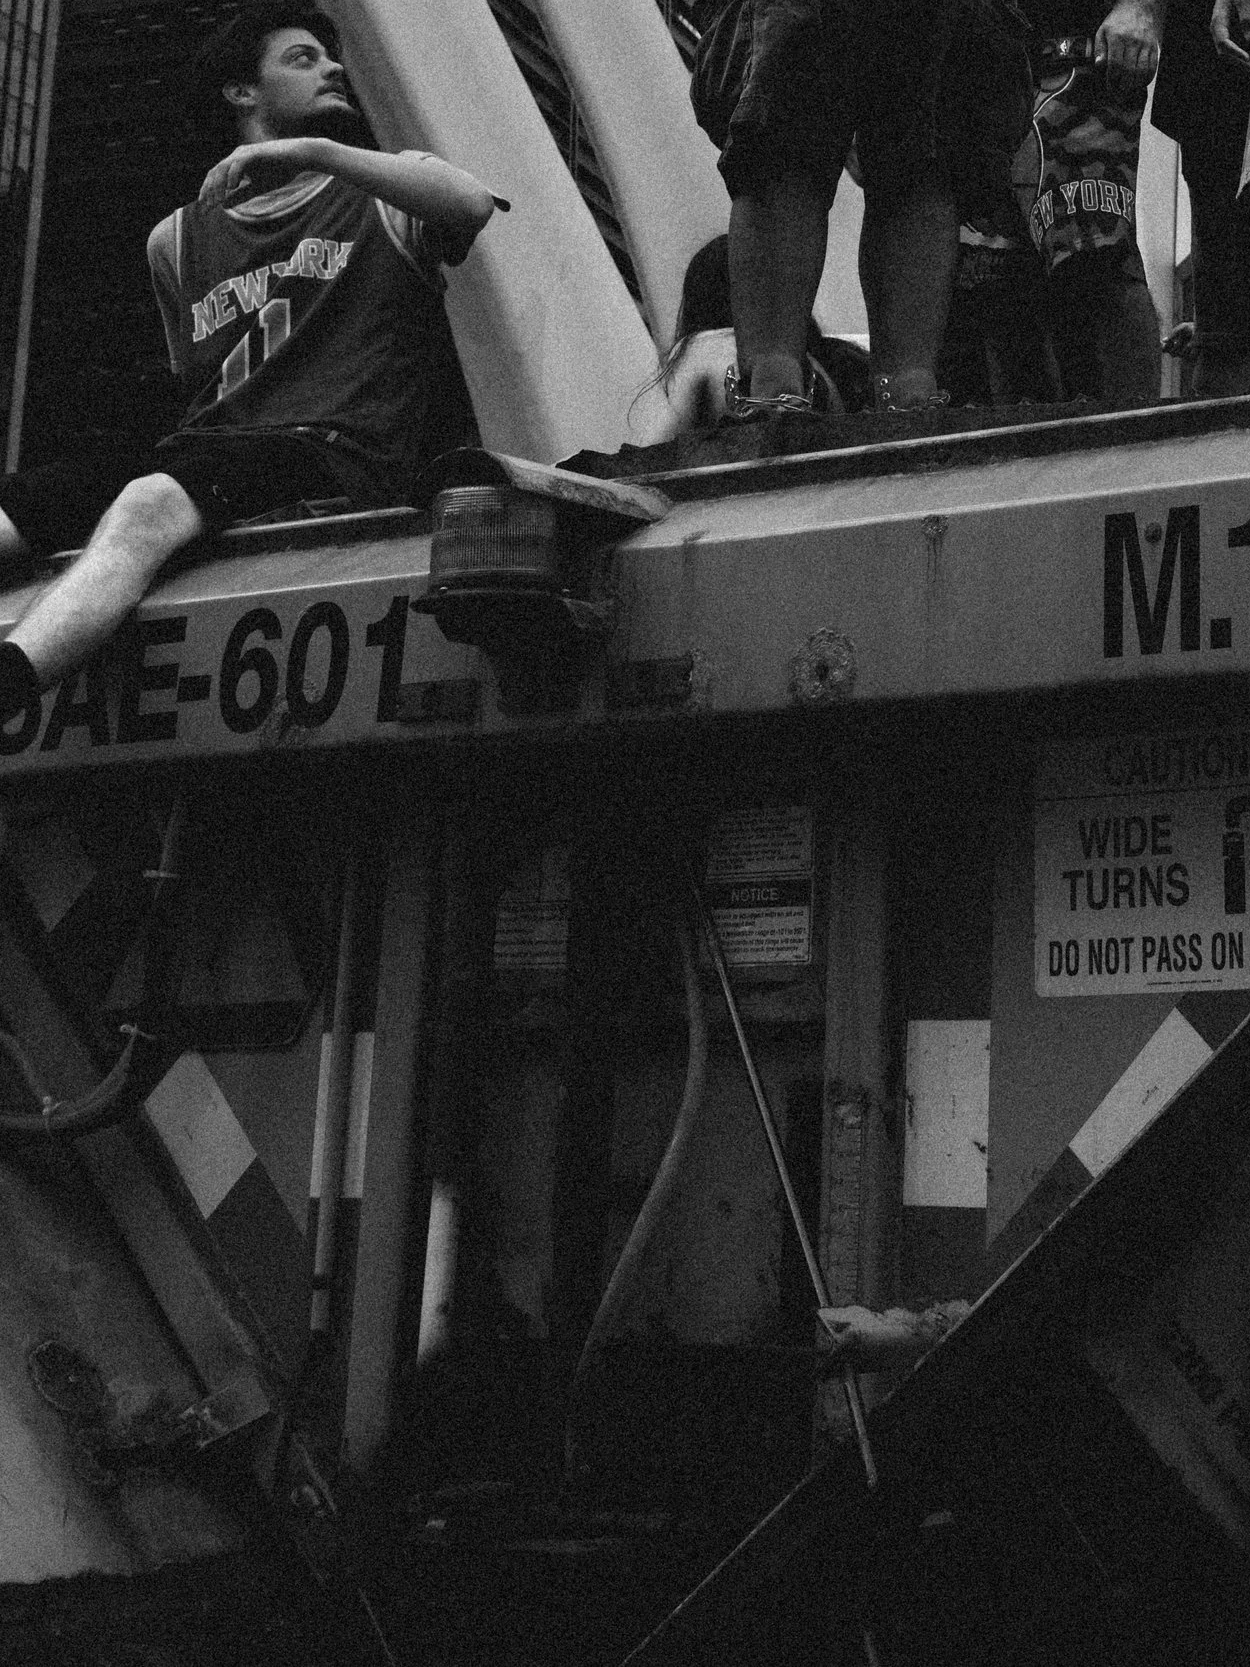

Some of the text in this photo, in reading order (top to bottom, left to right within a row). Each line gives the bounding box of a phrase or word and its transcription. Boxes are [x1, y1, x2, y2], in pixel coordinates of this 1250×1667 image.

[191, 265, 271, 343] NEW
[1102, 732, 1249, 786] CAUTION
[1078, 814, 1173, 859] WIDE
[731, 886, 778, 903] NOTICE
[1062, 862, 1190, 911] TURNS
[1049, 939, 1080, 976] DO
[1088, 936, 1135, 975] NOT
[1142, 933, 1202, 973] PASS
[1211, 931, 1244, 970] ON
